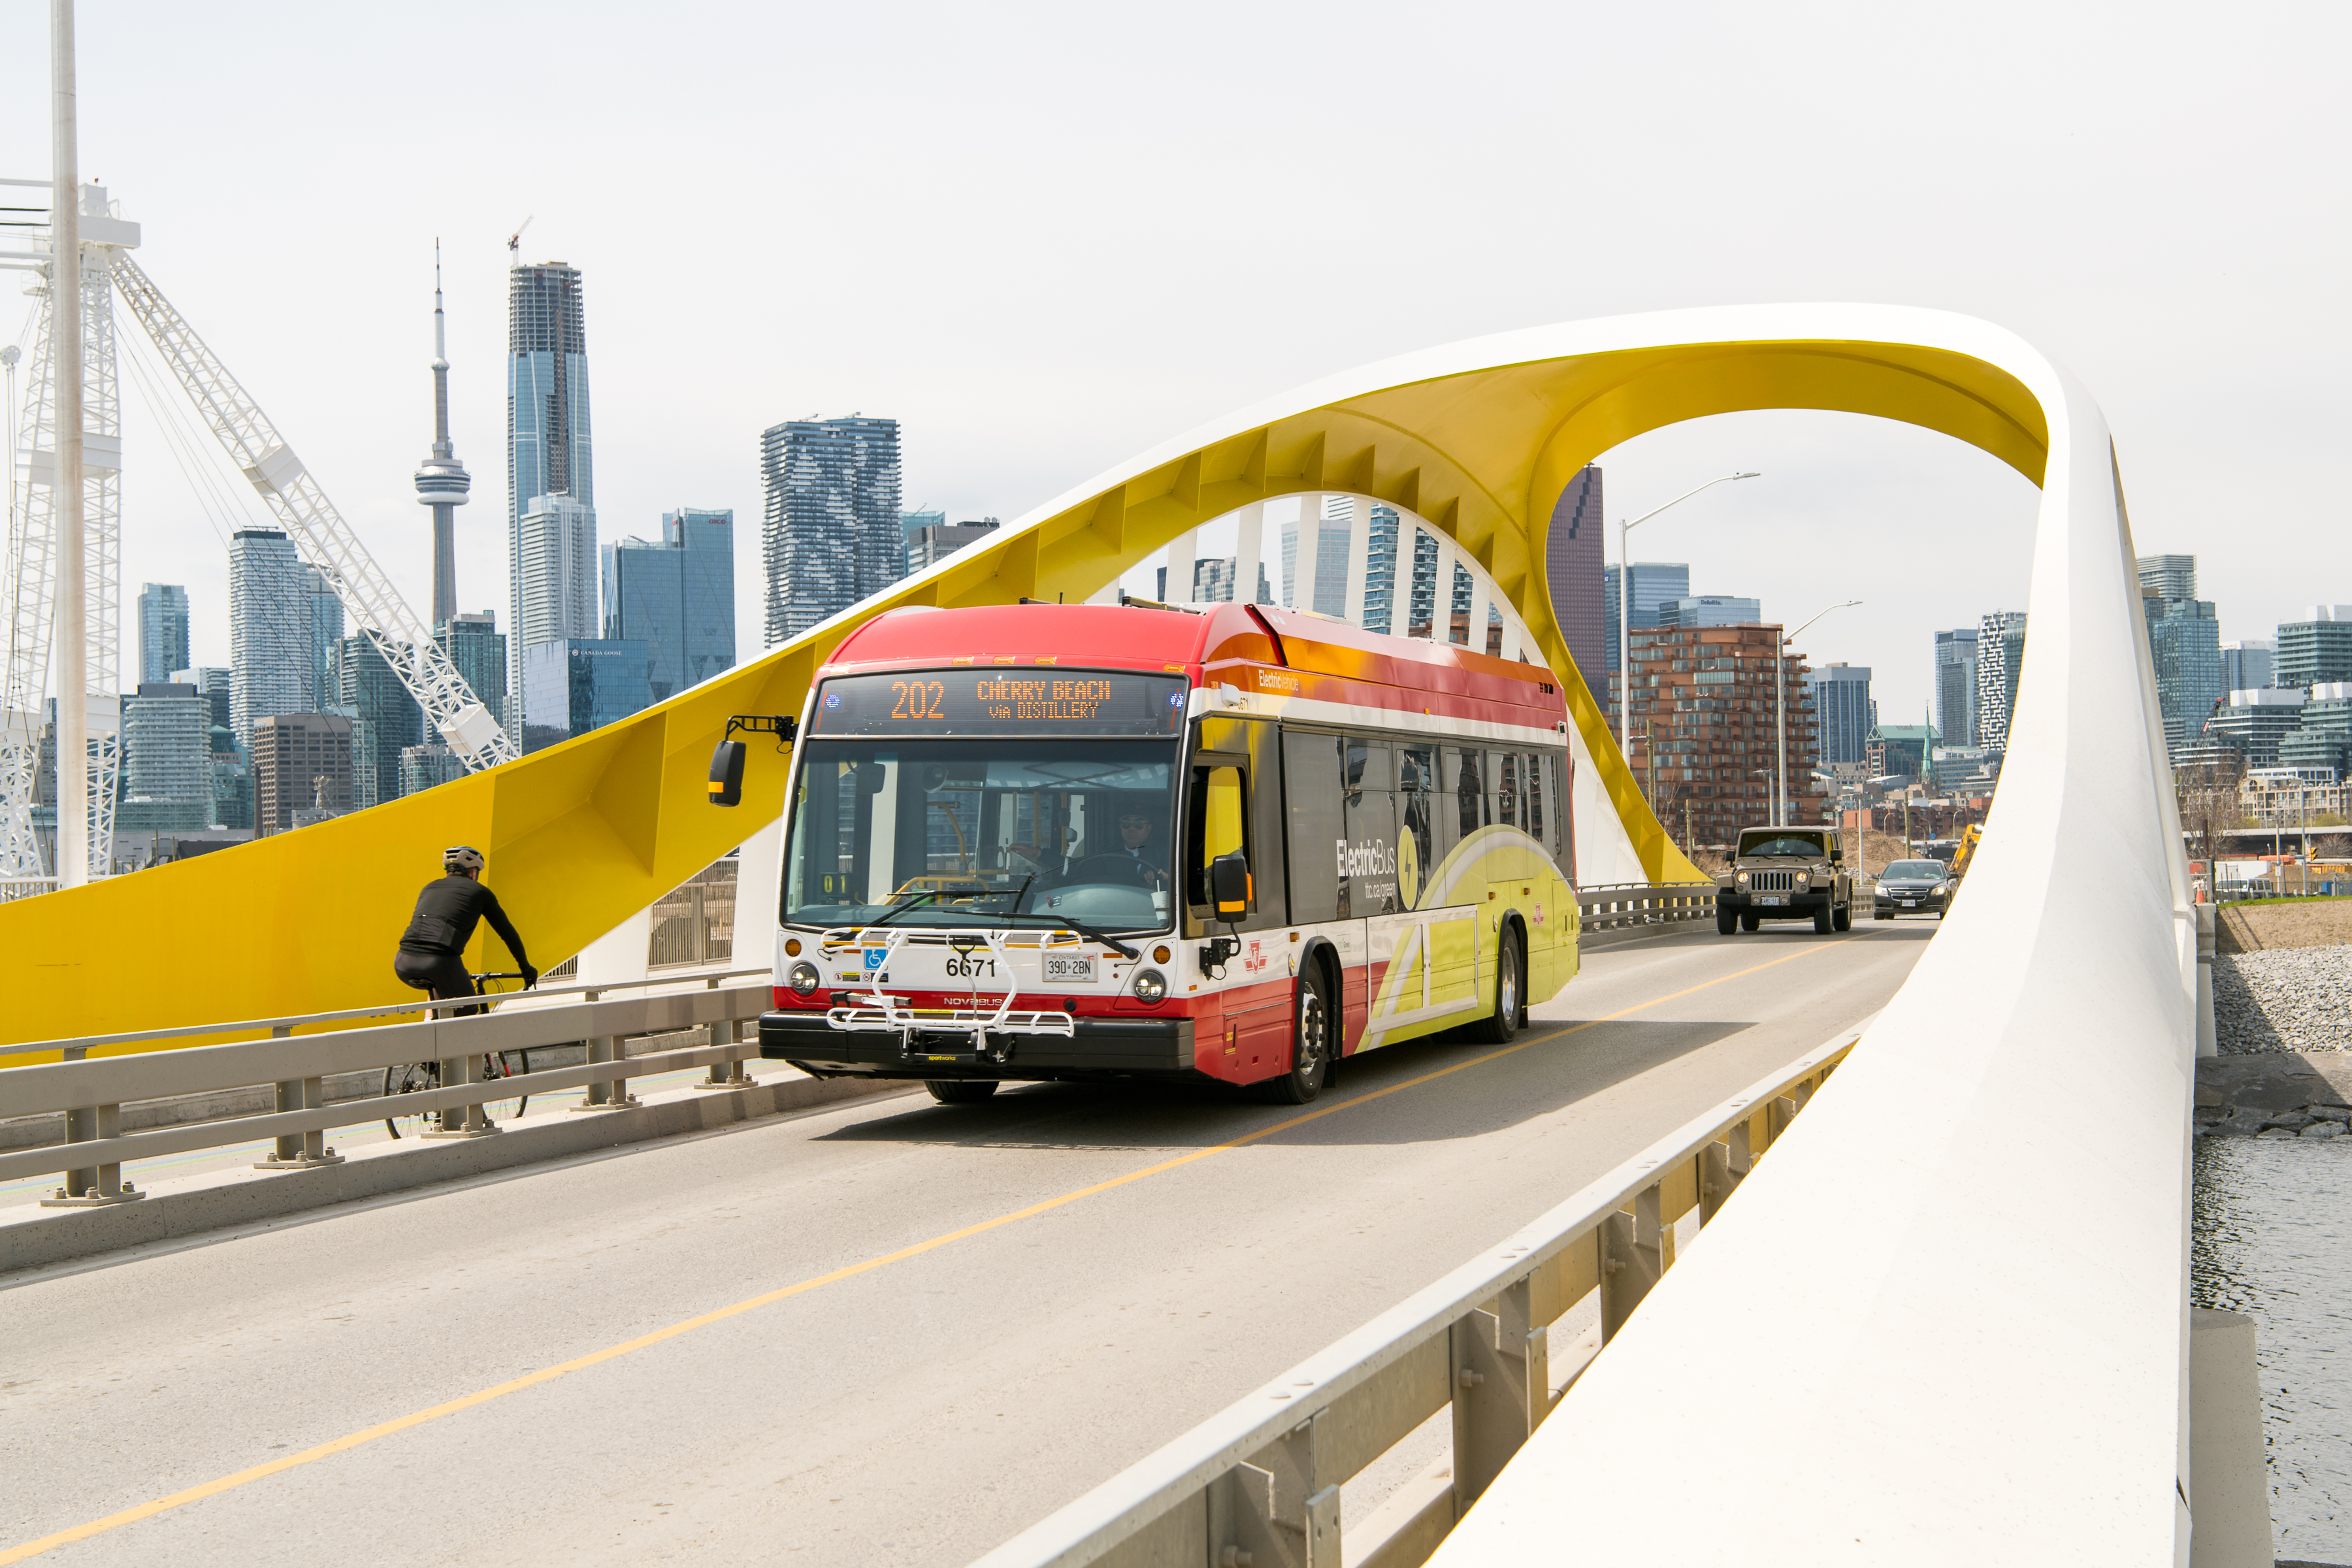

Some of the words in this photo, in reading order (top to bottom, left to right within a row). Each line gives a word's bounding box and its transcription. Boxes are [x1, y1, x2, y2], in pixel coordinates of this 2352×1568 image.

[892, 681, 944, 718] 202
[977, 681, 1046, 700] CHERRY
[1053, 681, 1110, 700] BEACH
[1018, 702, 1098, 718] DISTILLERY
[1336, 839, 1395, 877] ElectricBus
[1365, 879, 1396, 902] ttc.ca/green
[946, 958, 995, 977] 6671
